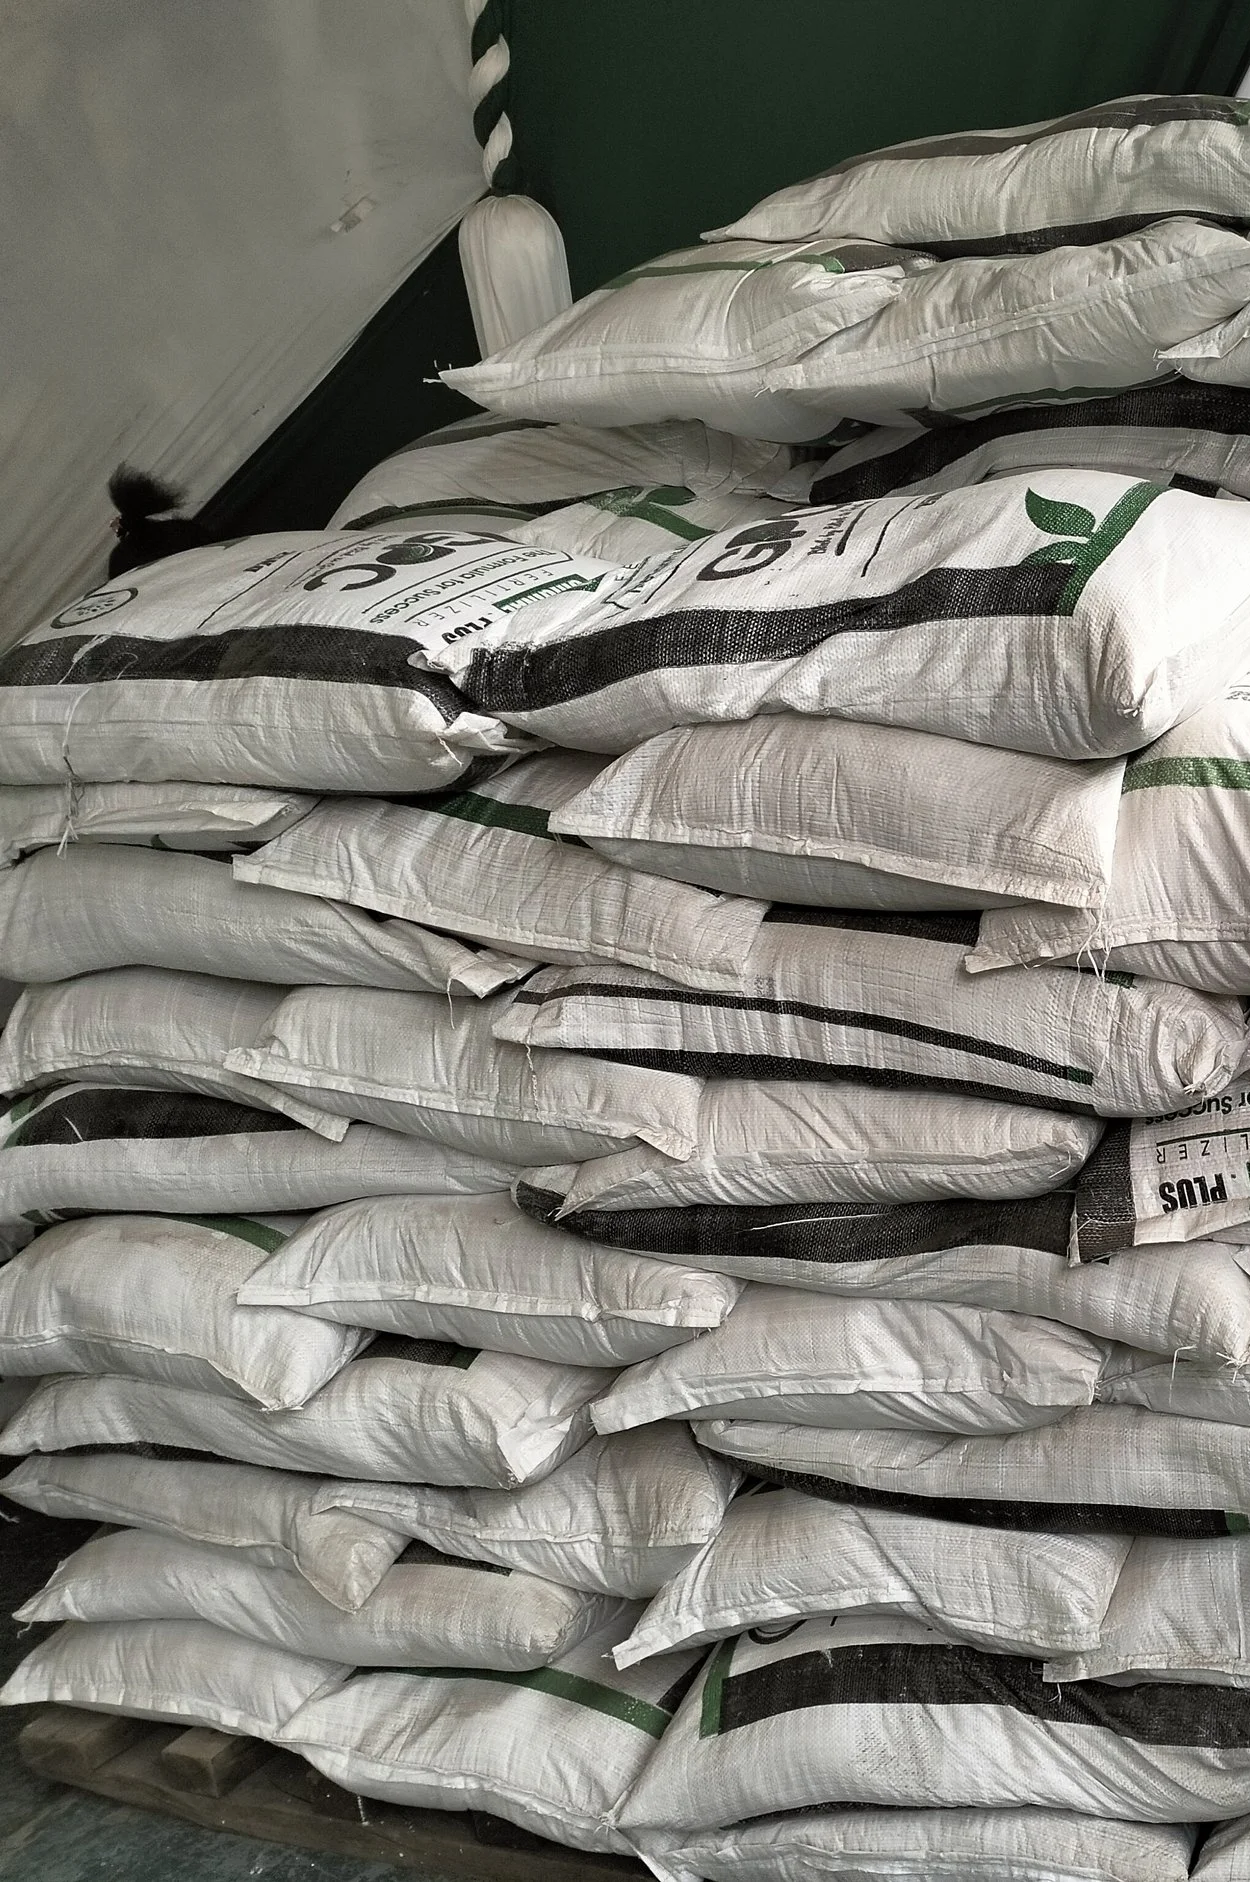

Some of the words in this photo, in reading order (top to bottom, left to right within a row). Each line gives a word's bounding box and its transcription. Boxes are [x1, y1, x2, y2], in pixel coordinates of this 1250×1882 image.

[435, 579, 465, 591] for
[461, 557, 529, 579] Formula
[369, 589, 441, 624] Success
[413, 569, 554, 627] FERTILIZER
[1158, 1172, 1228, 1214] PLUS
